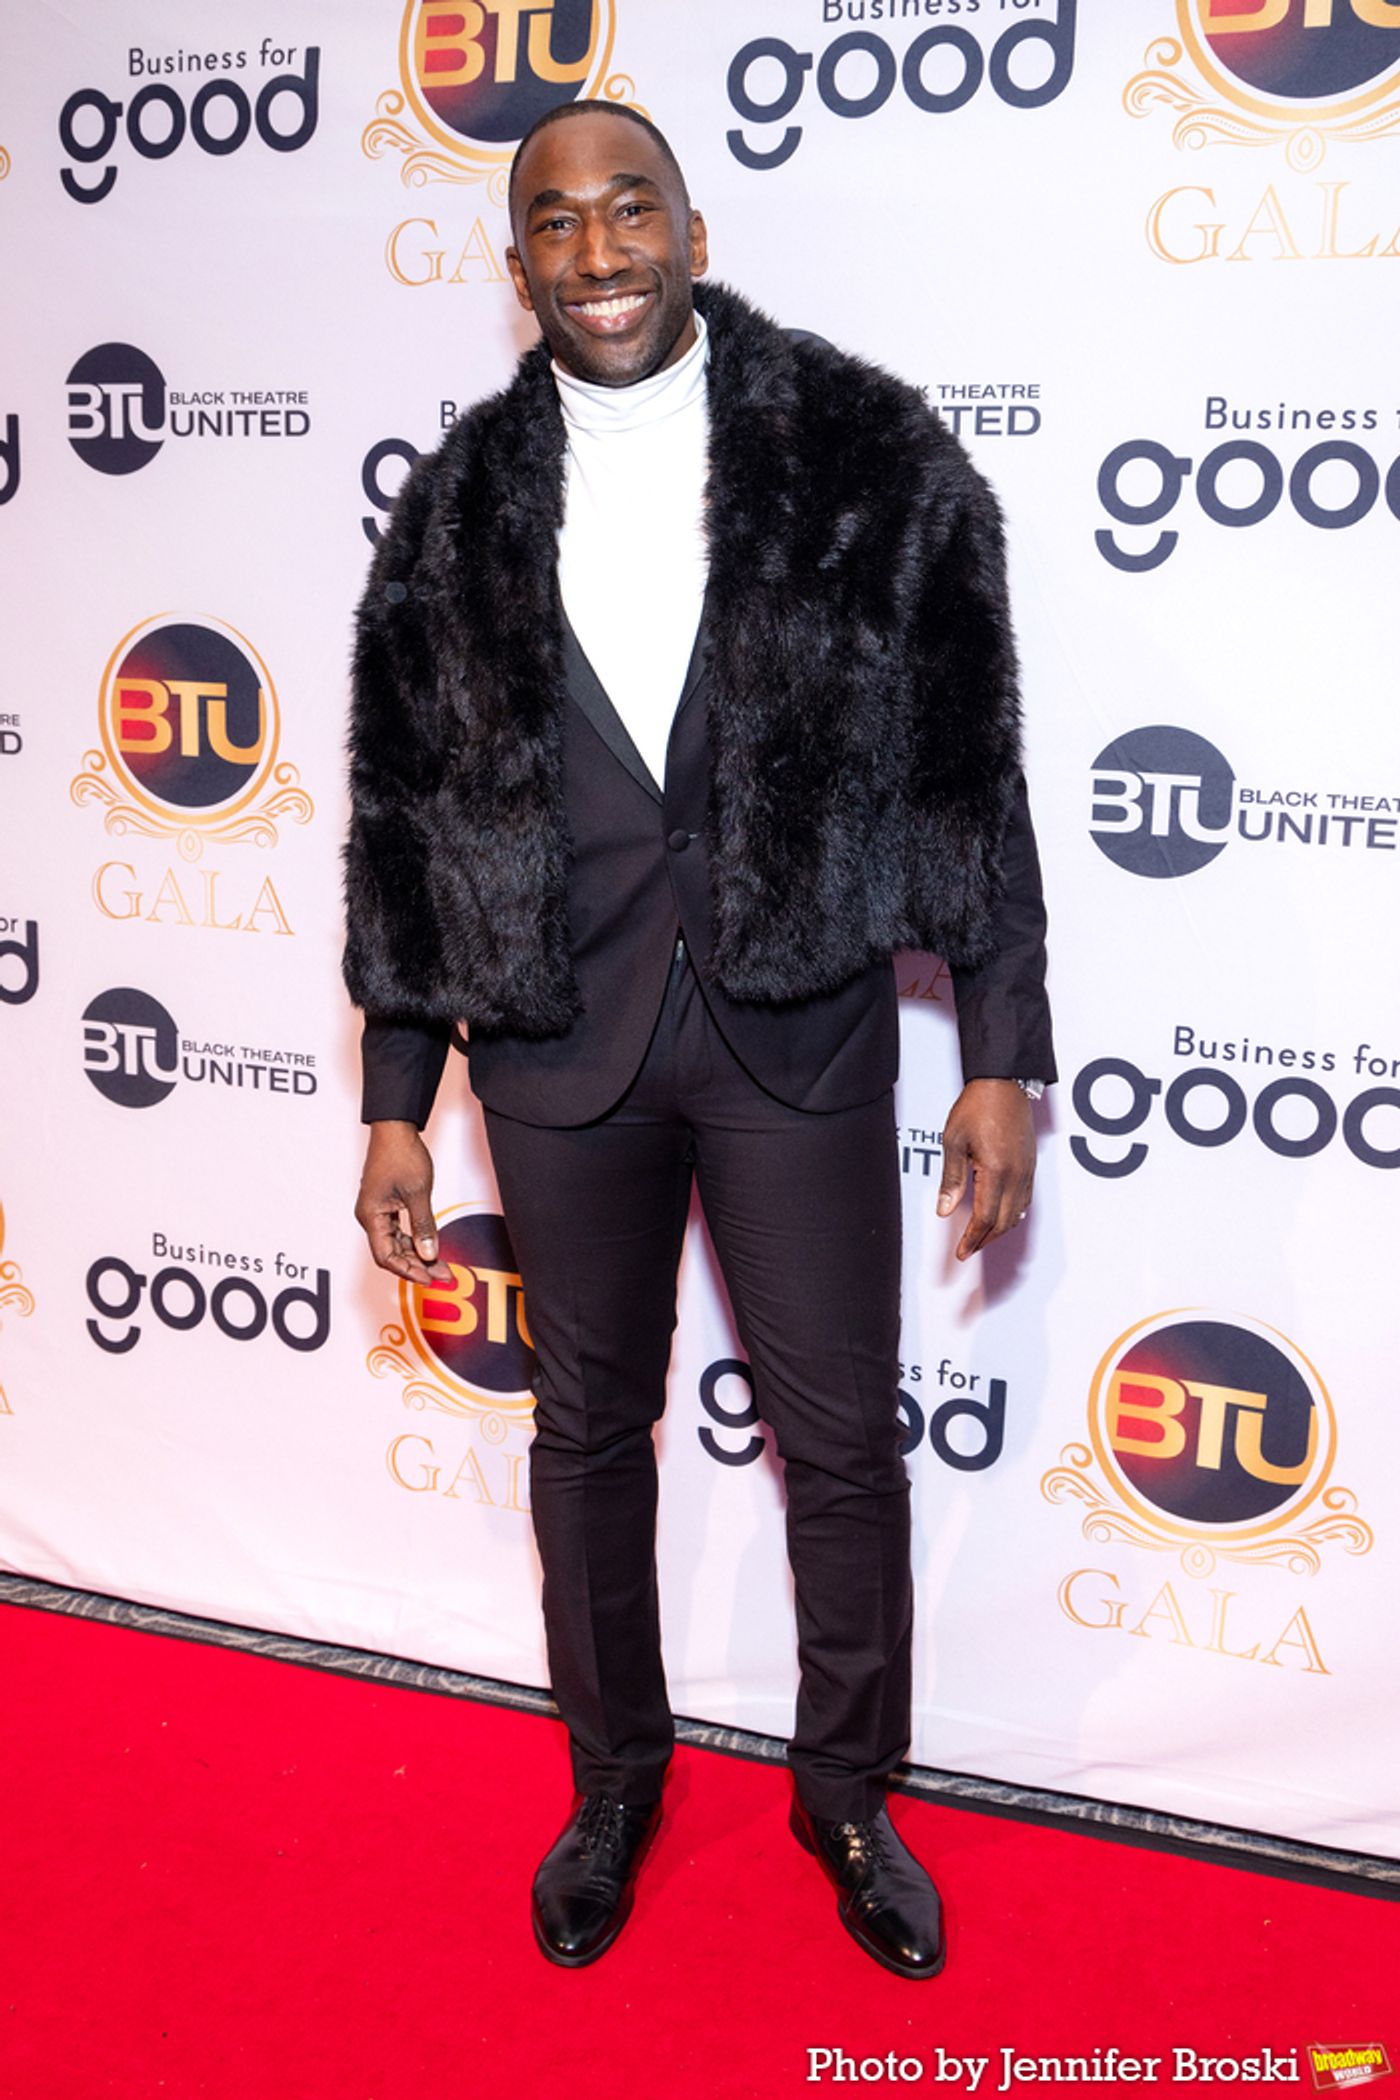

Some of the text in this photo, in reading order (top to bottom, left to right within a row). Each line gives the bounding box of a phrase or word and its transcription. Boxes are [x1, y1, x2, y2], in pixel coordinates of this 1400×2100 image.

[822, 0, 982, 23] Business
[128, 38, 298, 76] Business for
[414, 0, 602, 88] BTU
[726, 0, 1078, 171] good
[59, 46, 321, 205] good
[1145, 181, 1400, 265] GAL
[65, 382, 167, 443] BTU
[169, 391, 309, 405] BLACK THEATRE
[937, 384, 1041, 400] THEATRE
[1204, 396, 1379, 430] Business
[169, 410, 311, 437] UNITED
[1094, 438, 1400, 573] goo
[112, 677, 267, 765] BTU
[1088, 768, 1237, 844] BTU
[1238, 788, 1318, 808] BLACK
[1237, 809, 1399, 850] UNITE
[91, 861, 297, 937] GALA
[80, 1020, 179, 1084] BTU
[181, 1040, 317, 1068] BLACK THEATRE
[1173, 1025, 1337, 1072] Business
[182, 1056, 318, 1096] UNITED
[152, 1232, 309, 1280] Business for
[86, 1256, 331, 1355] good
[936, 1359, 981, 1391] for
[1108, 1370, 1320, 1486] BTU
[1056, 1567, 1334, 1676] GALA
